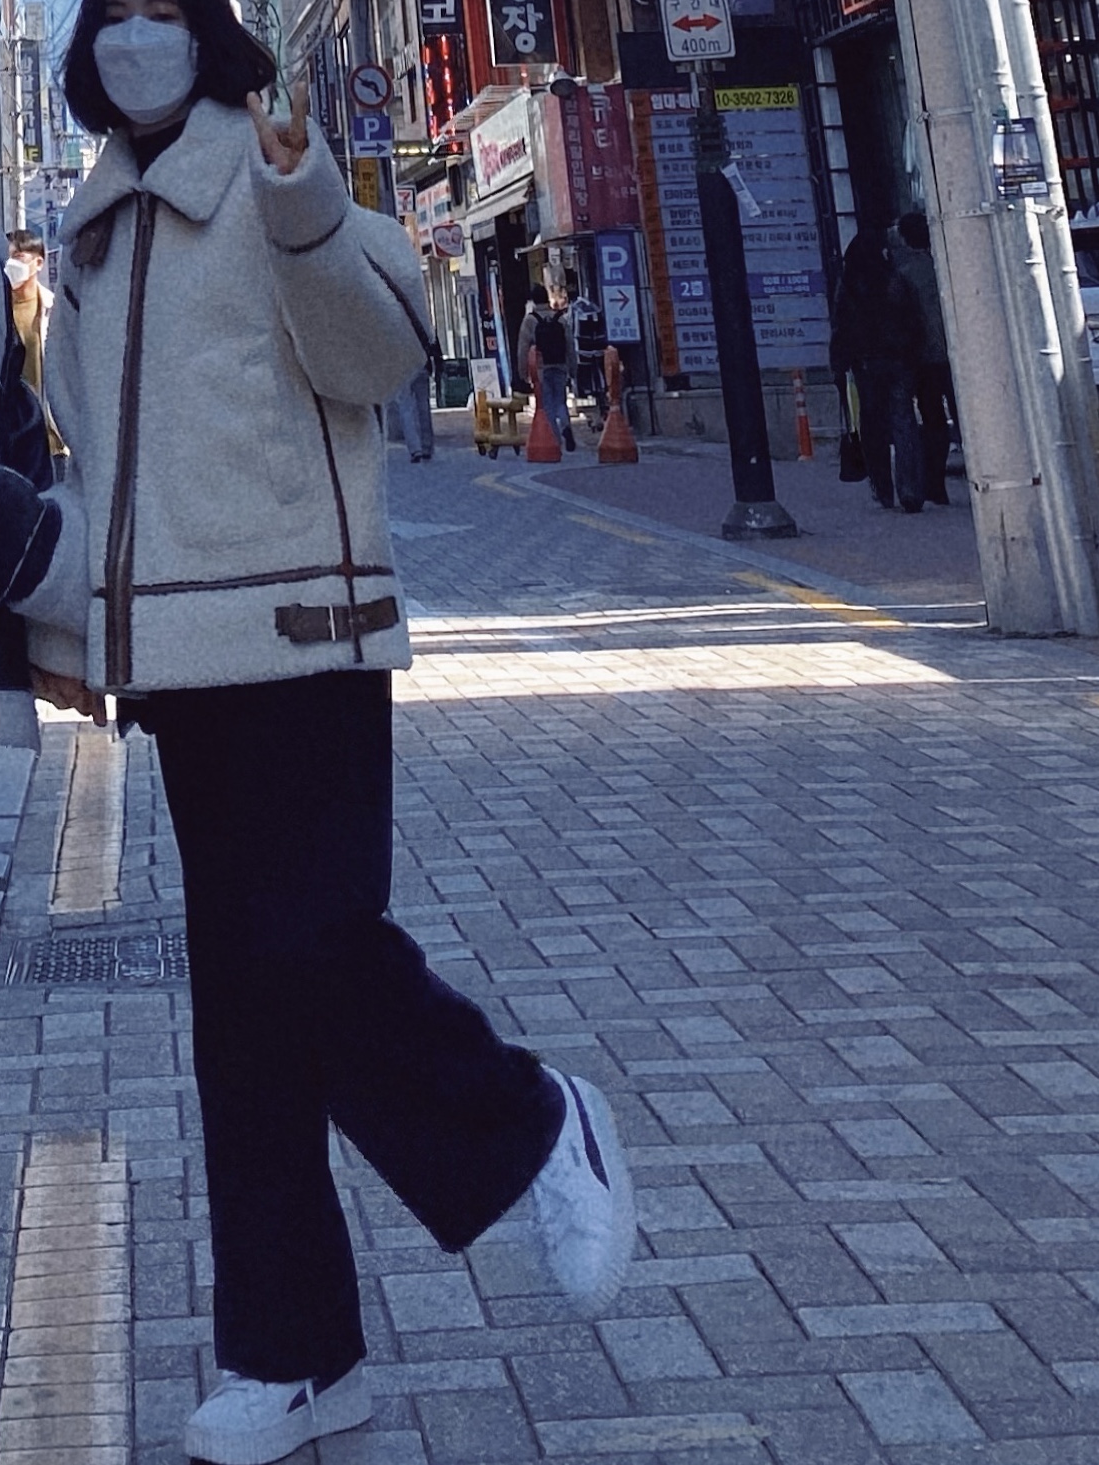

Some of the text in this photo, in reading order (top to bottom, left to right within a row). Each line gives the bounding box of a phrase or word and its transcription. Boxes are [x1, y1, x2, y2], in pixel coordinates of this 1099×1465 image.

[681, 38, 721, 53] 400m
[363, 117, 381, 141] P
[602, 245, 629, 280] P
[680, 280, 704, 297] 2층
